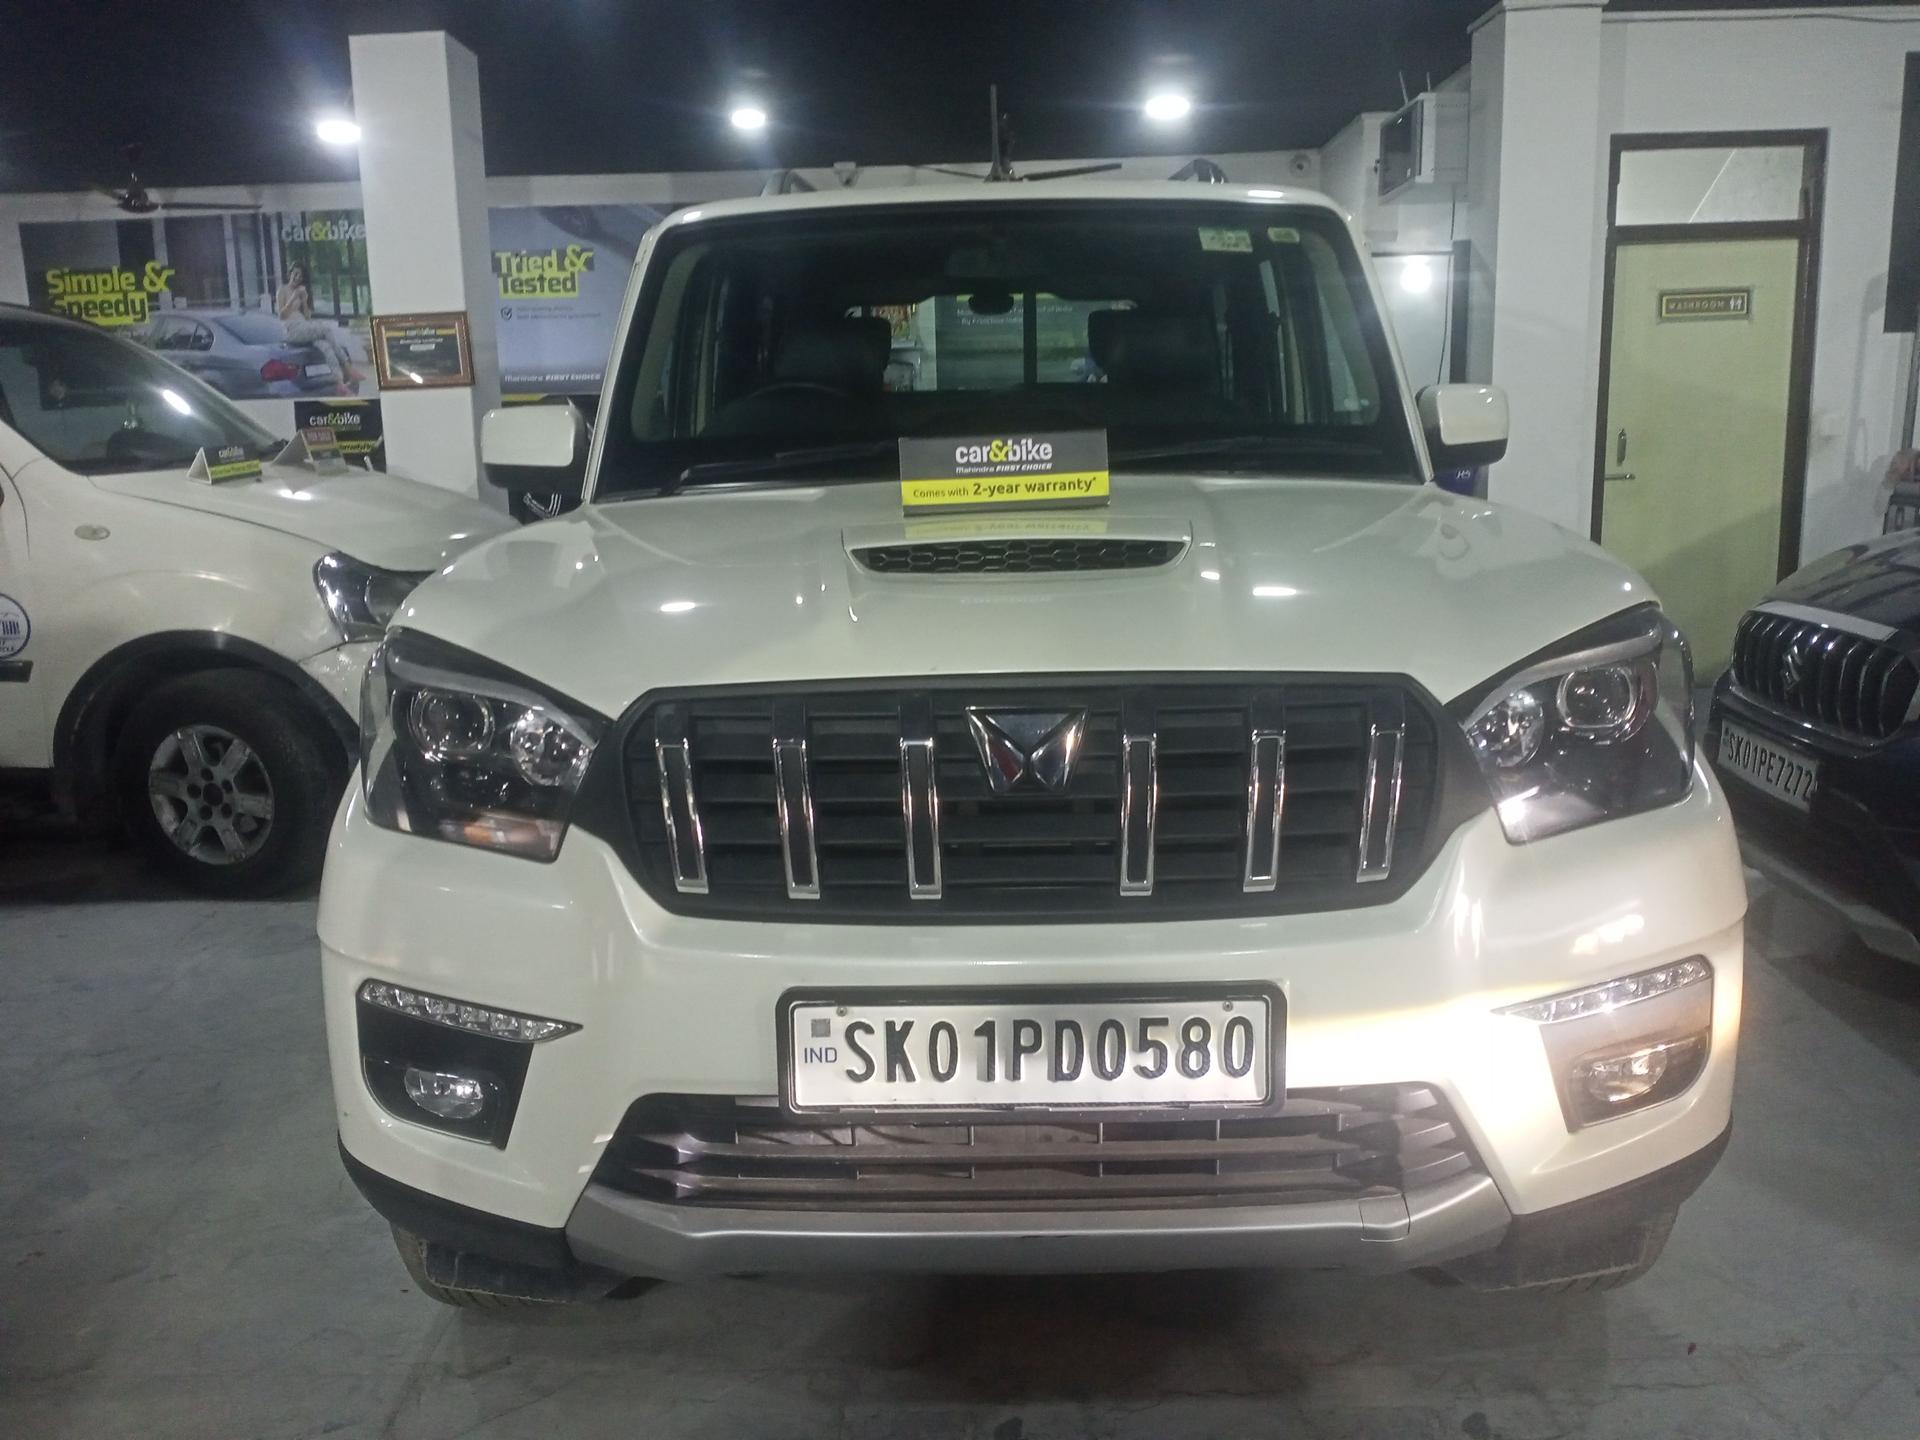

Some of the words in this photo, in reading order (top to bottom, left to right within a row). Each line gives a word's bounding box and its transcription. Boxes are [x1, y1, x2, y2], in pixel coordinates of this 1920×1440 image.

[496, 250, 558, 273] Tried
[563, 244, 595, 272] &
[46, 265, 135, 295] Simple
[143, 261, 175, 292] &
[500, 272, 577, 295] Tested
[955, 438, 1053, 463] car&bike
[956, 466, 994, 474] Mahindra
[996, 464, 1020, 472] FIRST
[1021, 463, 1052, 471] CHOICE
[913, 489, 946, 498] Comes
[949, 487, 969, 497] with
[973, 482, 1020, 497] 2-year
[1728, 733, 1812, 802] SK01PE7272
[804, 1047, 838, 1064] IND
[844, 1015, 1255, 1083] SK01PD0580
